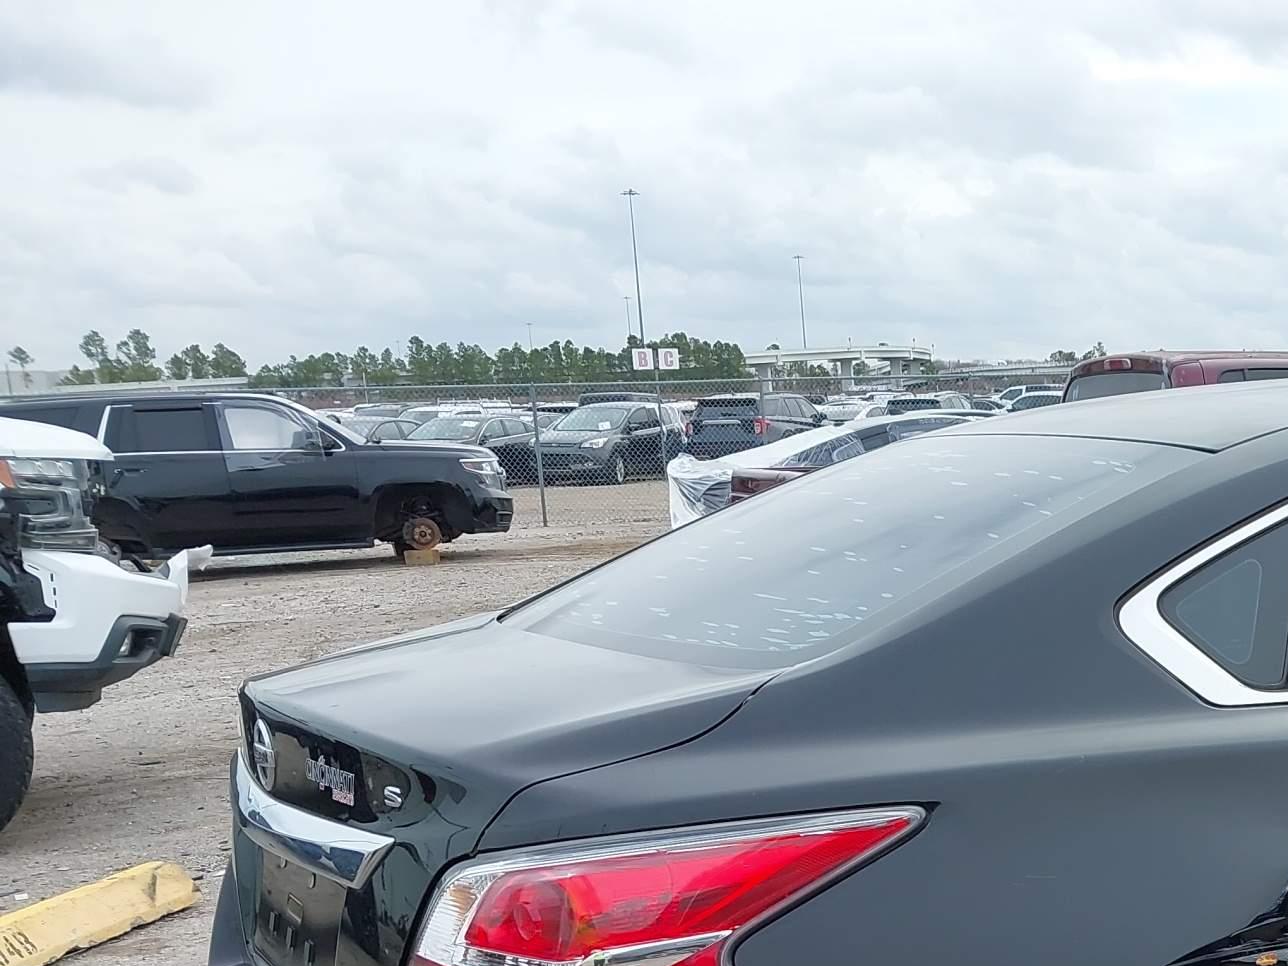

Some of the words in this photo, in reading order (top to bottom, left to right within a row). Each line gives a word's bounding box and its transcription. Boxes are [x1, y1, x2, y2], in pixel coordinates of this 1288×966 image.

[637, 351, 649, 367] B
[663, 351, 674, 367] C
[383, 785, 402, 808] S
